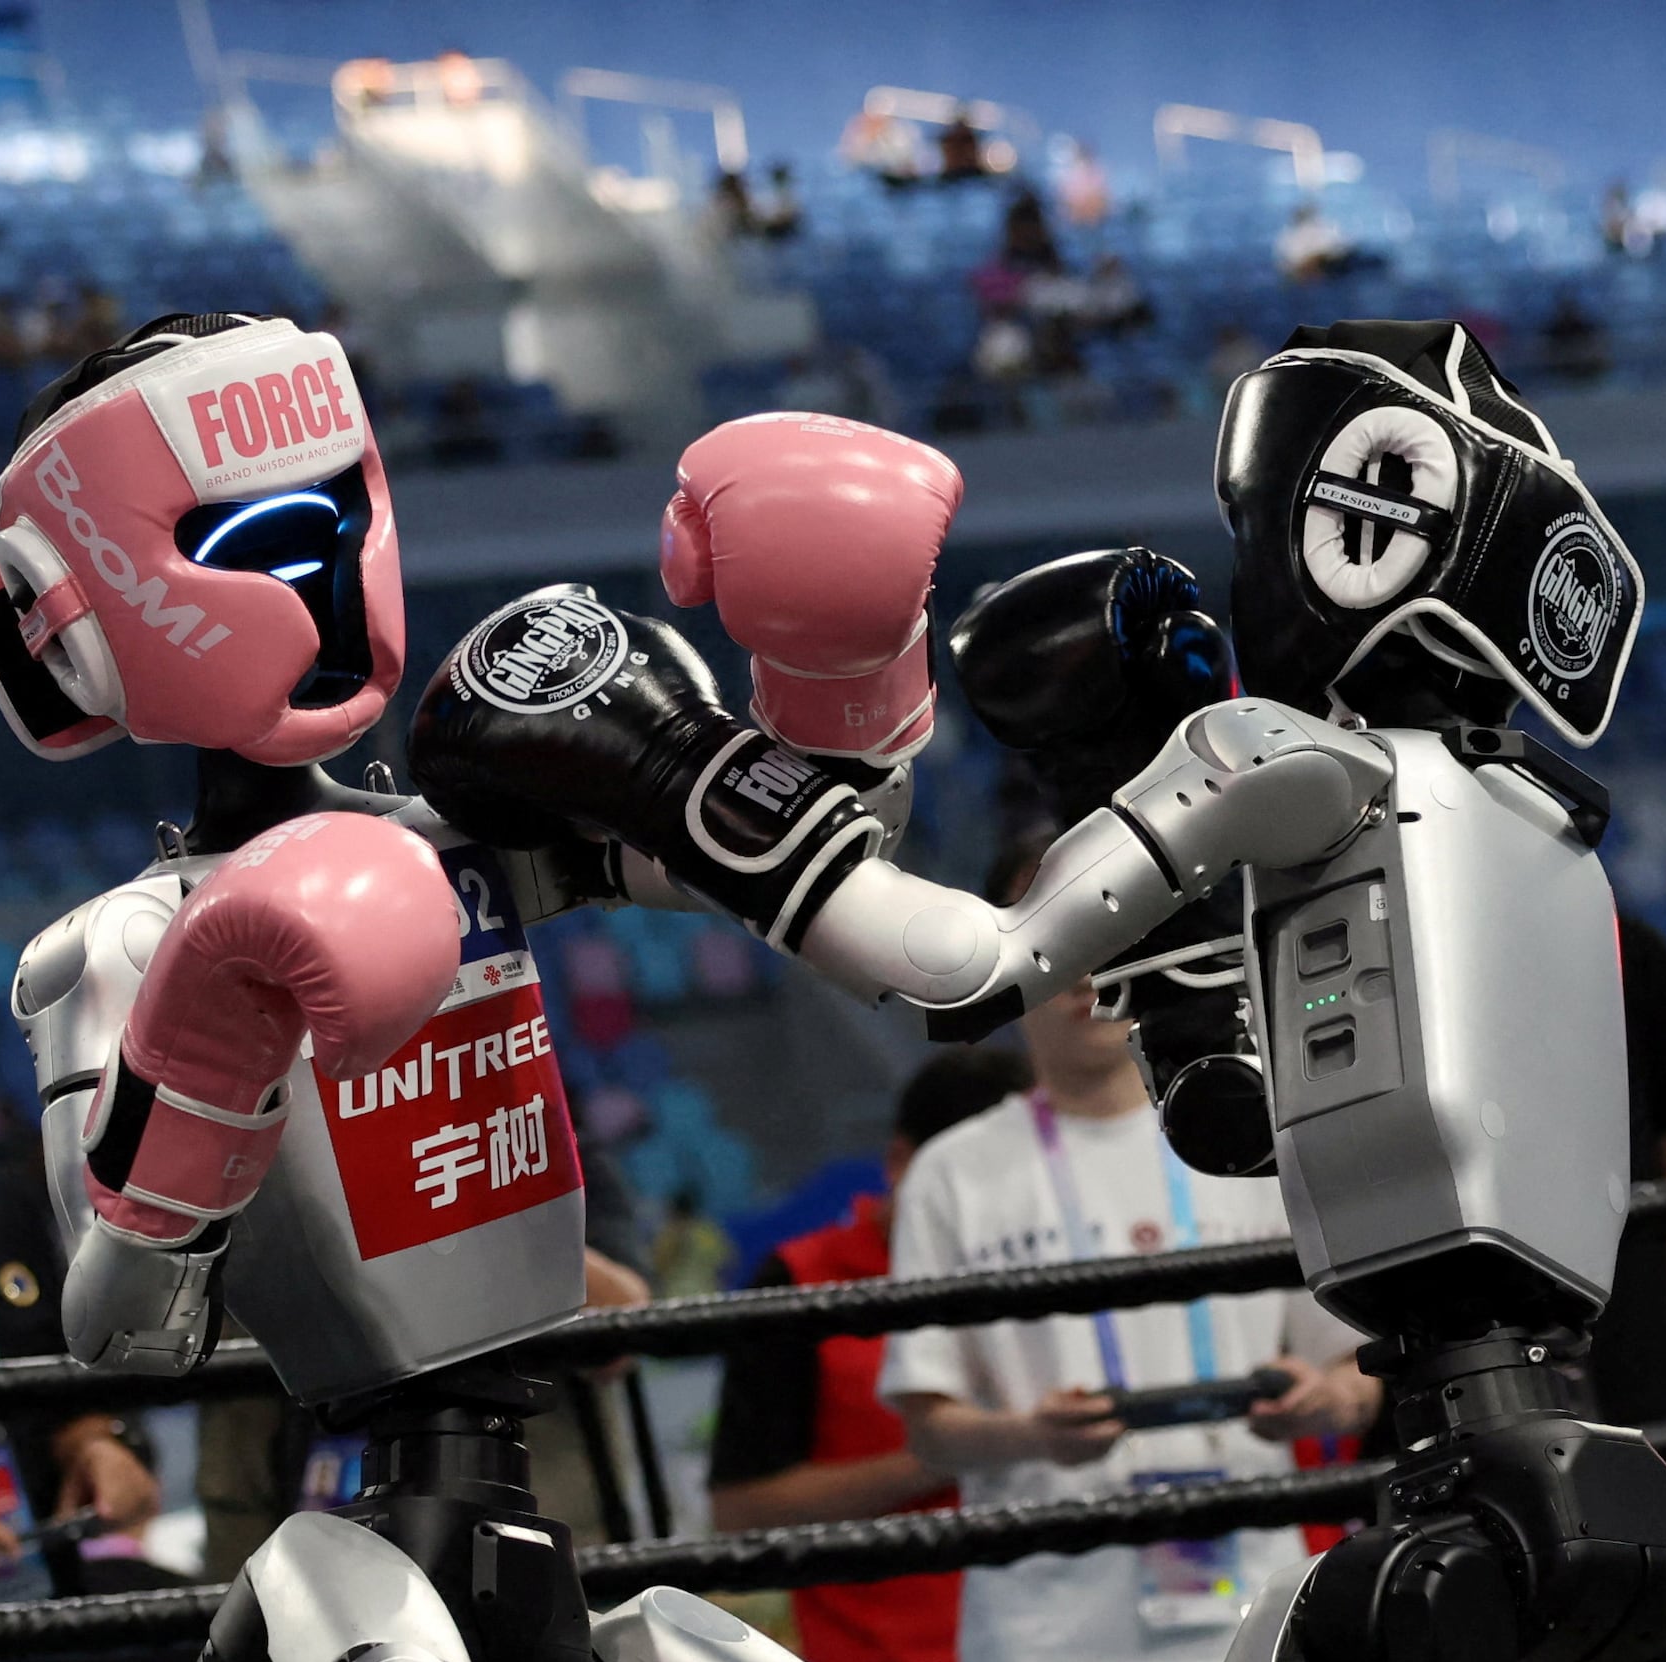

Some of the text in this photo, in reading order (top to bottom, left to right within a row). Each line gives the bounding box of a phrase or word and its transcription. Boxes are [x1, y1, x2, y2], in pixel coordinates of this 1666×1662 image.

[187, 358, 354, 469] FORCE
[205, 437, 361, 489] BRAND WISDOM AND CHARM
[1320, 487, 1410, 519] VERSION 2.0
[1545, 511, 1584, 538] GINGPAI
[1539, 552, 1609, 659] GINGPAI
[486, 599, 609, 700] GINGPAI
[547, 637, 579, 671] BOXING
[547, 687, 575, 703] FROM
[576, 668, 601, 690] CHINA
[599, 647, 615, 670] SINCE
[783, 795, 804, 819] BRAND
[451, 868, 505, 938] 2
[339, 1014, 551, 1119] UNITREE
[411, 1093, 549, 1209] 宇树
